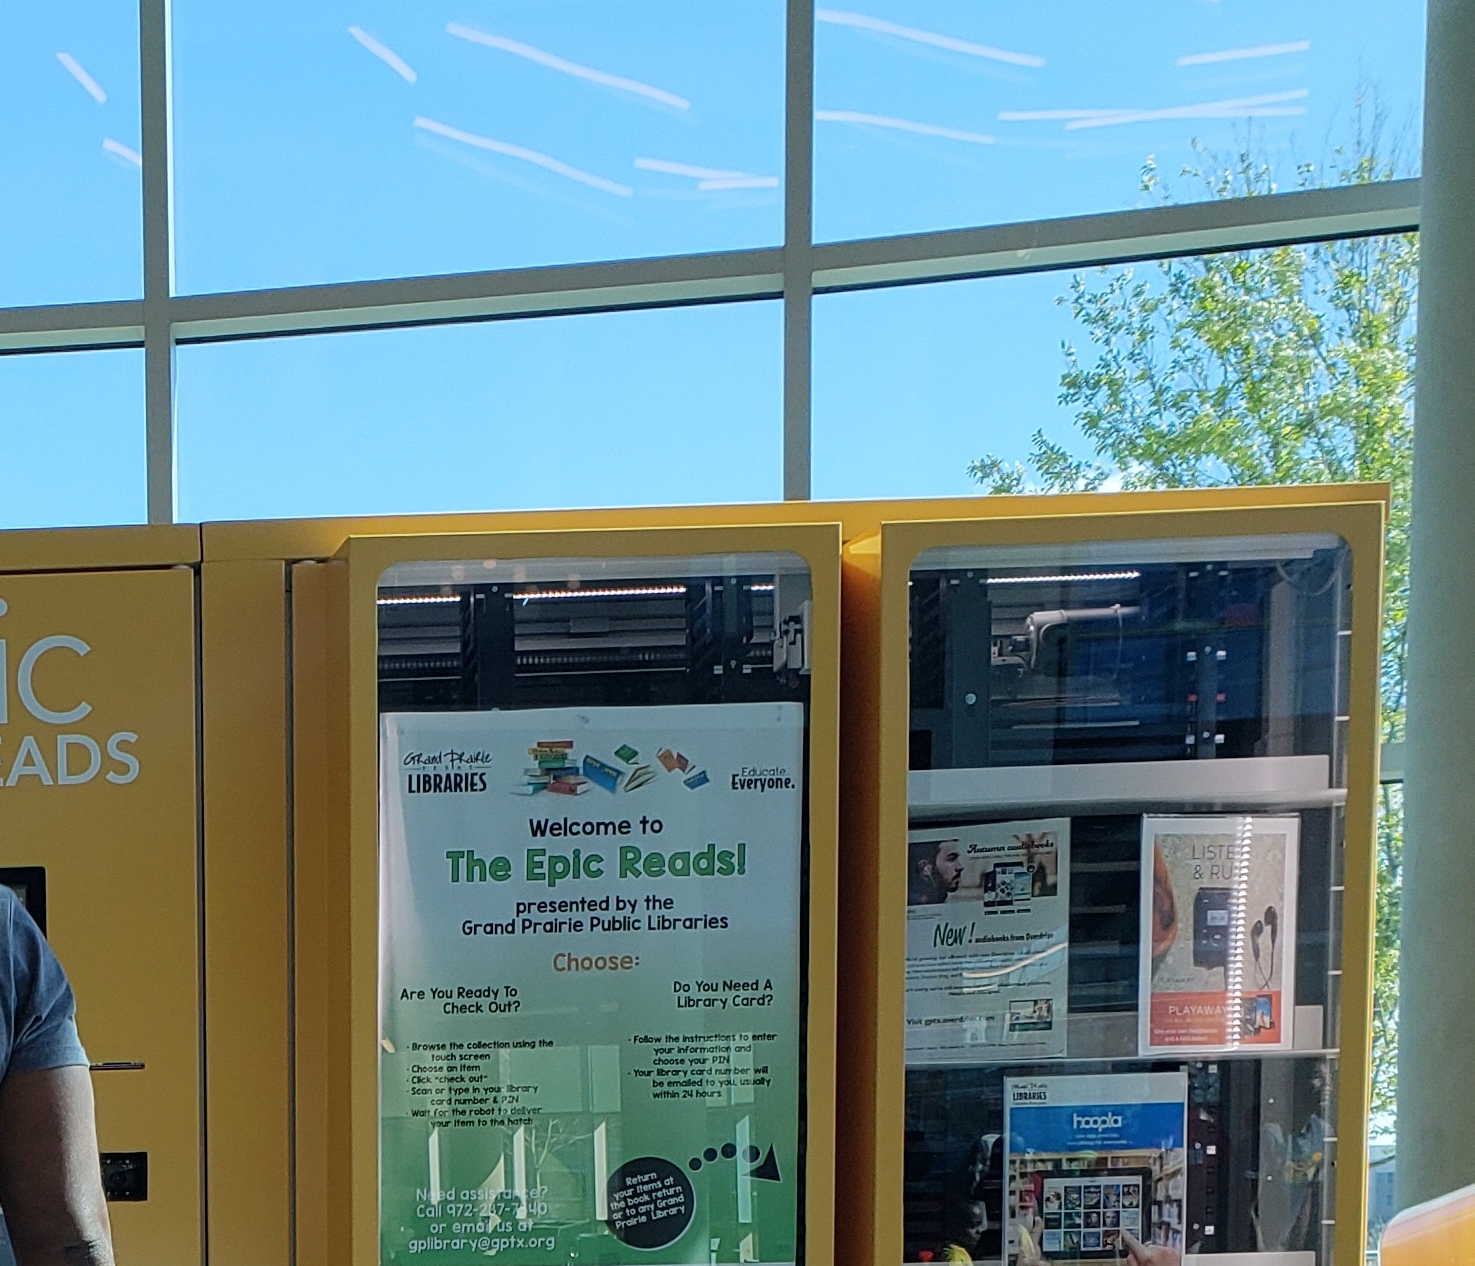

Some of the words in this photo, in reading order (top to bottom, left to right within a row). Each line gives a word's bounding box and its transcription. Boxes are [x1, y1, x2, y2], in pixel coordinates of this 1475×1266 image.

[741, 766, 787, 777] Educate
[408, 772, 487, 794] LIBRARIES
[731, 774, 796, 793] Everyone.
[528, 817, 632, 838] Welcome
[639, 816, 664, 835] to
[1192, 843, 1239, 861] LISTE
[446, 850, 512, 883] The
[525, 848, 605, 888] Epic
[618, 843, 746, 879] Reads!
[1193, 864, 1204, 880] &
[515, 896, 611, 917] presented
[614, 897, 639, 914] by
[644, 895, 674, 911] the
[461, 919, 516, 937] Grand
[521, 917, 585, 935] Prairie
[589, 916, 642, 933] Public
[647, 914, 729, 932] Libraries
[933, 921, 976, 948] New!
[552, 953, 641, 973] Choose:
[400, 988, 426, 1001] Are
[430, 987, 453, 1000] You
[457, 986, 500, 1001] Ready
[503, 985, 518, 998] To
[673, 980, 691, 993] Do
[695, 980, 719, 992] You
[722, 979, 759, 992] Need
[763, 979, 773, 991] A
[443, 1001, 484, 1015] Check
[488, 1000, 521, 1013] Out?
[677, 995, 728, 1010] Library
[732, 994, 774, 1008] Card?
[1168, 1004, 1228, 1017] PLAYAWAY
[411, 1042, 447, 1051] Browse
[449, 1041, 464, 1050] the
[466, 1040, 510, 1050] collection
[512, 1040, 536, 1049] using
[538, 1039, 554, 1048] the
[633, 1035, 662, 1044] Follow
[665, 1034, 680, 1043] the
[682, 1033, 737, 1043] instructions
[739, 1033, 749, 1041] to
[751, 1032, 778, 1041] enter
[431, 1052, 457, 1062] touch
[458, 1052, 491, 1061] screen
[653, 1046, 675, 1056] your
[677, 1045, 732, 1055] information
[734, 1043, 752, 1053] and
[411, 1064, 444, 1074] Choose
[459, 1063, 481, 1073] item
[653, 1057, 685, 1066] choose
[688, 1057, 710, 1067] your
[712, 1056, 730, 1064] PIN
[633, 1068, 654, 1077] Your
[656, 1068, 688, 1078] library
[690, 1067, 713, 1076] card
[714, 1066, 751, 1076] number
[753, 1065, 769, 1075] will
[411, 1075, 432, 1085] Click
[652, 1079, 664, 1088] be
[666, 1078, 703, 1087] emailed
[705, 1078, 716, 1086] to
[739, 1077, 772, 1087] usually
[411, 1086, 432, 1096] Scan
[435, 1087, 446, 1095] or
[447, 1086, 470, 1096] type
[472, 1086, 481, 1094] in
[483, 1086, 504, 1096] your
[506, 1084, 539, 1094] library
[652, 1089, 680, 1099] within
[681, 1089, 694, 1099] 24
[695, 1089, 722, 1098] hours
[430, 1097, 452, 1106] card
[454, 1096, 490, 1105] number
[492, 1096, 499, 1104] &
[501, 1095, 519, 1104] PIN
[411, 1107, 431, 1118] Wait
[433, 1107, 449, 1117] for
[451, 1107, 467, 1116] the
[469, 1106, 496, 1116] robot
[498, 1107, 508, 1115] to
[510, 1105, 543, 1115] deliver
[430, 1119, 452, 1129] your
[453, 1118, 475, 1127] item
[477, 1117, 487, 1127] to
[490, 1117, 505, 1127] the
[507, 1116, 534, 1126] hatch
[1072, 1111, 1123, 1132] hoopla
[625, 1172, 658, 1187] Return
[460, 1186, 548, 1201] assistane?
[613, 1188, 635, 1201] your
[636, 1180, 663, 1193] items
[663, 1176, 675, 1186] at
[609, 1200, 626, 1211] the
[627, 1193, 651, 1206] book
[651, 1185, 683, 1200] return
[416, 1204, 442, 1218] Call
[612, 1211, 624, 1220] or
[625, 1207, 636, 1217] to
[637, 1203, 655, 1213] any
[656, 1193, 685, 1208] Grand
[615, 1215, 647, 1230] Prairie
[651, 1204, 685, 1220] Library
[430, 1223, 447, 1234] or
[452, 1221, 491, 1233] email
[497, 1221, 513, 1232] us
[517, 1219, 534, 1231] at
[408, 1235, 555, 1254] gplibrary@gptx.org
